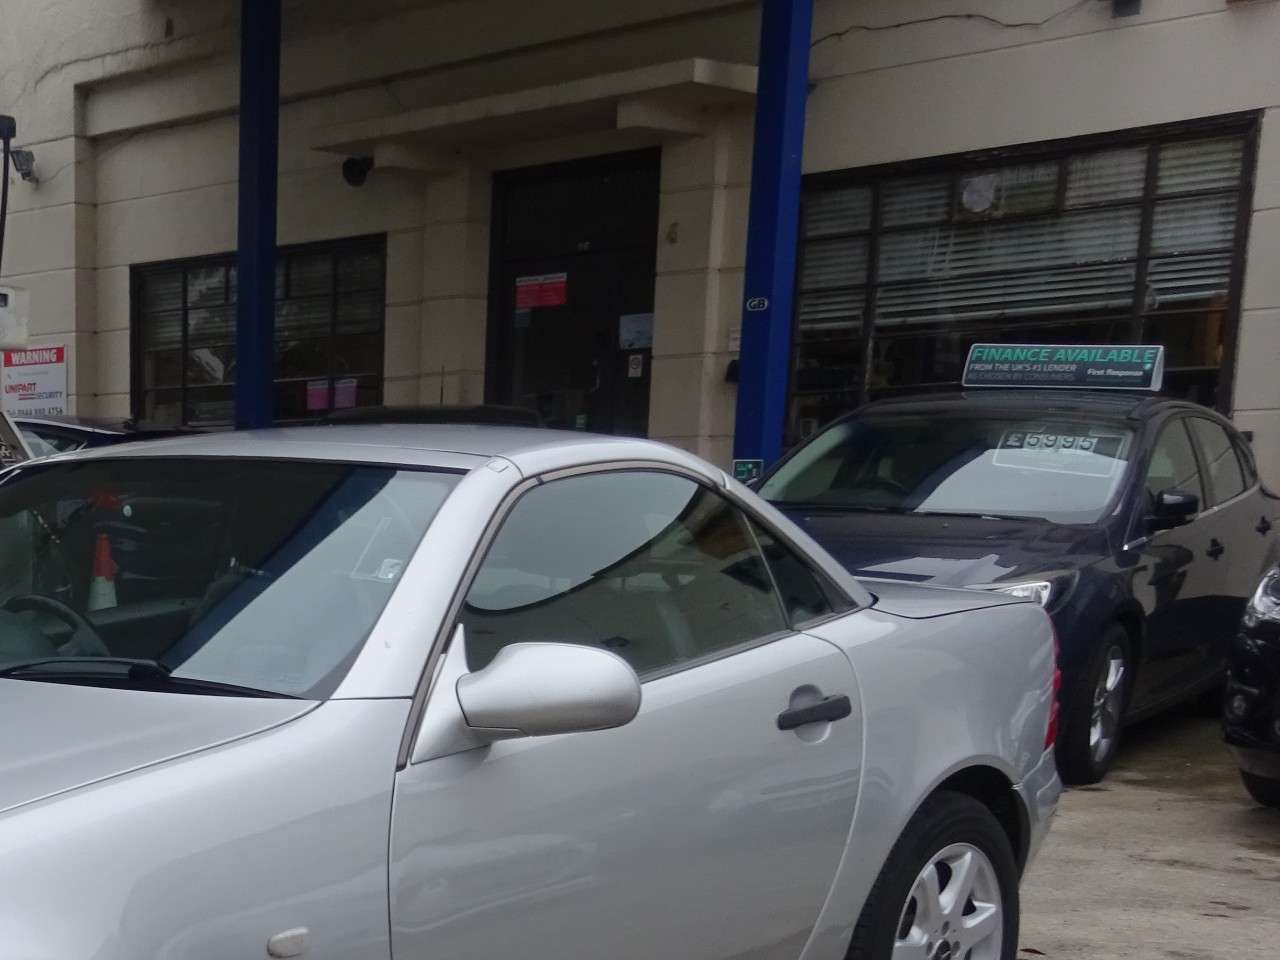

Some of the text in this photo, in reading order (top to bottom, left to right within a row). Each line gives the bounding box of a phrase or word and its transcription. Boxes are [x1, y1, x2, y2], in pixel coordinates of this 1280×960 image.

[12, 350, 56, 365] WARNING
[971, 348, 1156, 362] FINANCE AVAILABLE
[5, 382, 37, 394] UNIPART
